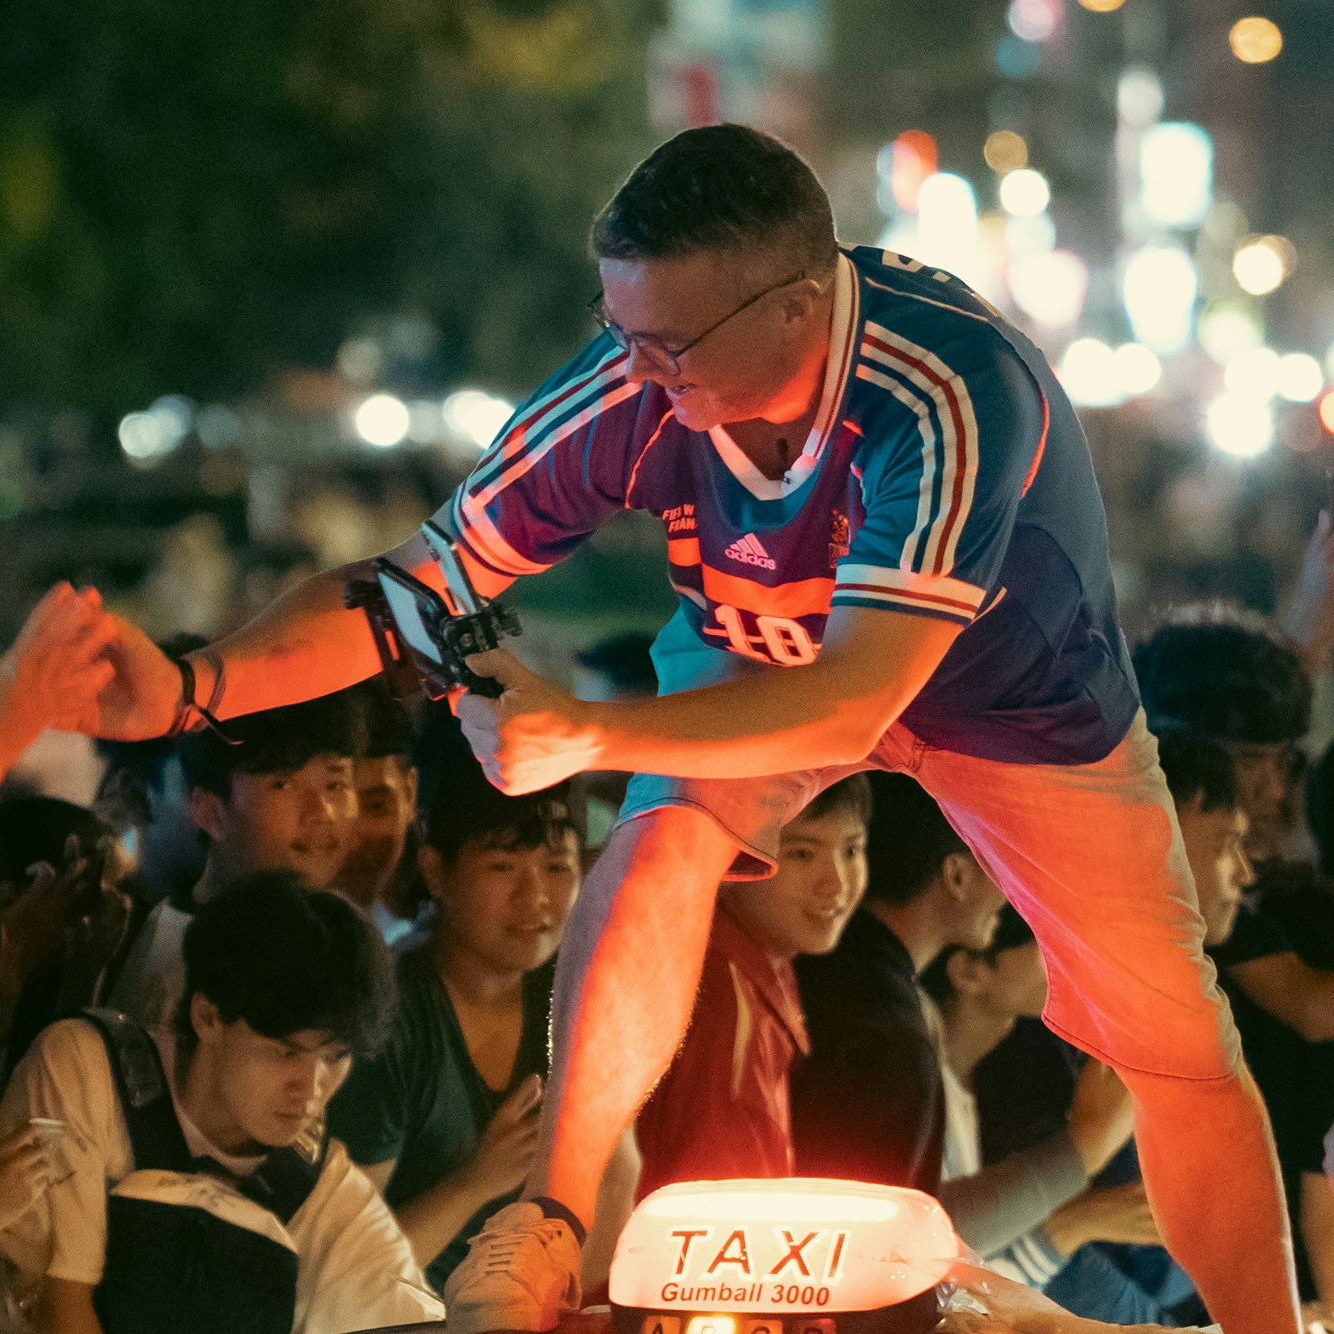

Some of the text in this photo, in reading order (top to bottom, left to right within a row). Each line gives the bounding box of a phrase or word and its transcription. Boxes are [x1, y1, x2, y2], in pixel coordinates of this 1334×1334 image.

[724, 548, 776, 571] adidas
[714, 604, 820, 667] 10
[670, 1229, 849, 1281] TAXI
[661, 1282, 830, 1306] Gumball 3000
